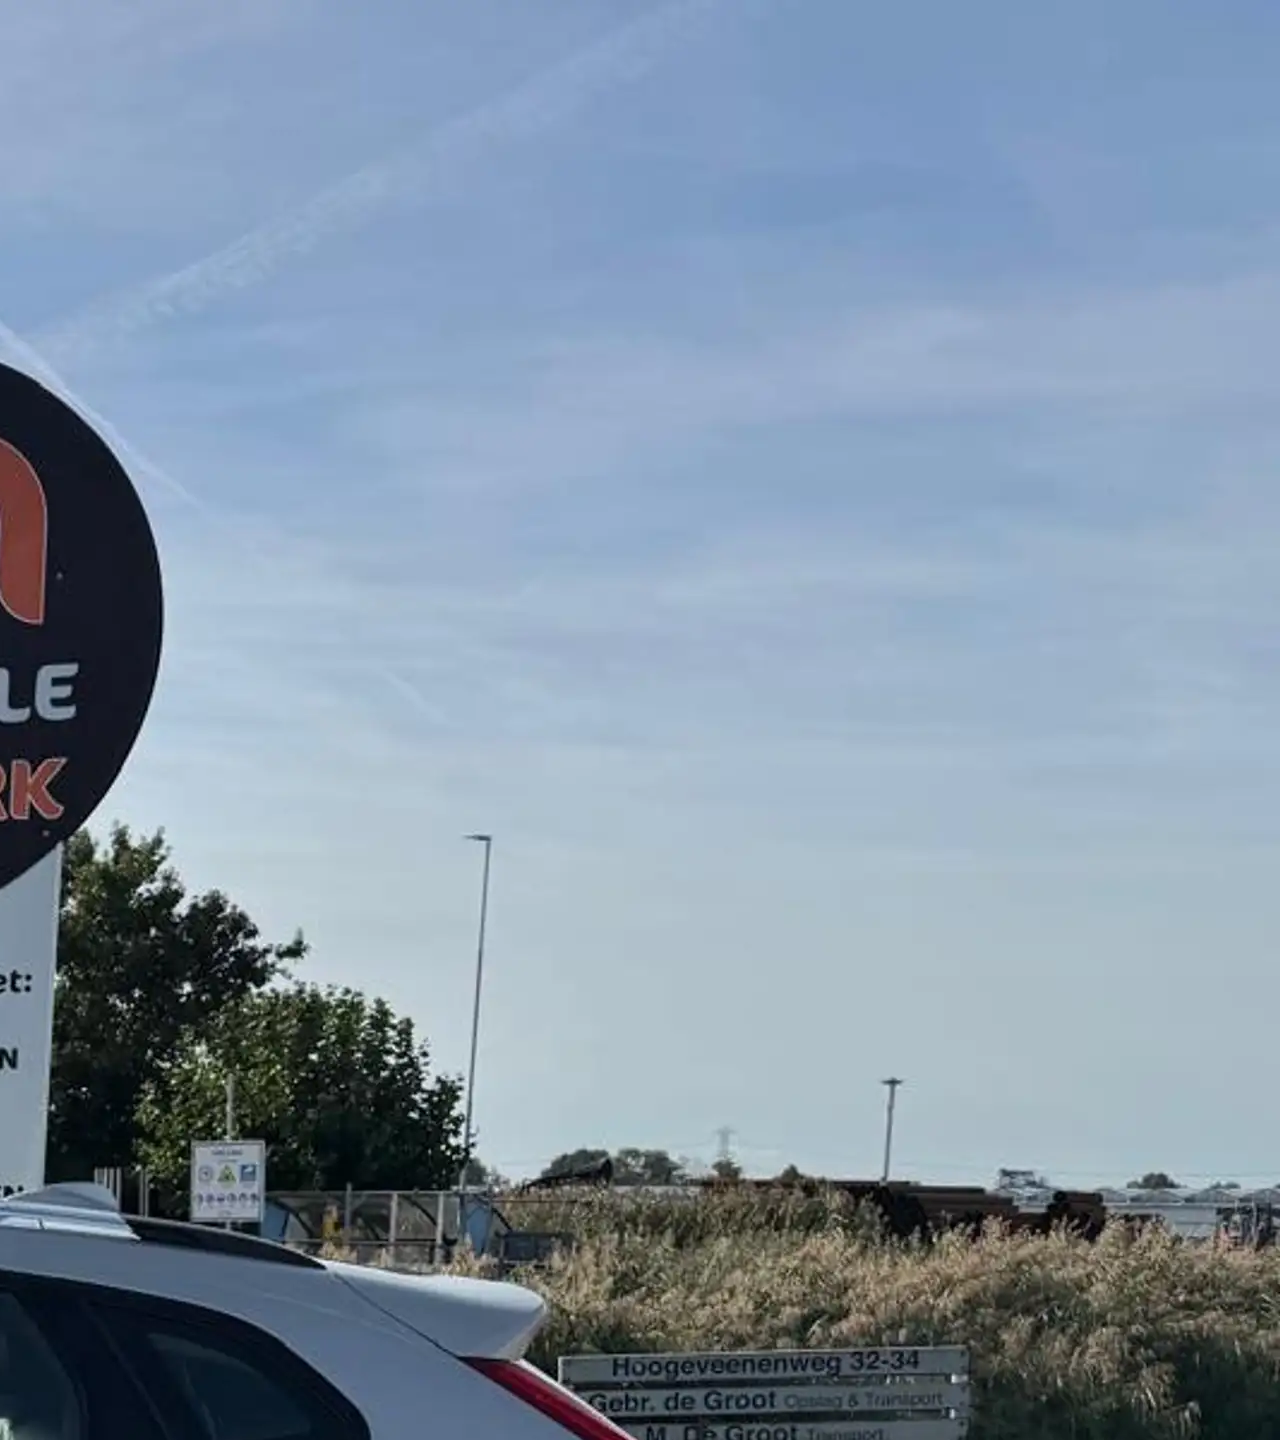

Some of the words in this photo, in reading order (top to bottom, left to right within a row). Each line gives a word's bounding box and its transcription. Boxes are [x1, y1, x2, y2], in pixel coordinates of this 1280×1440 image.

[612, 1355, 841, 1379] Hoogeveenenweg
[850, 1350, 920, 1371] 32-34
[589, 1392, 655, 1413] Gebr.
[664, 1391, 696, 1412] de
[704, 1390, 777, 1411] Groot
